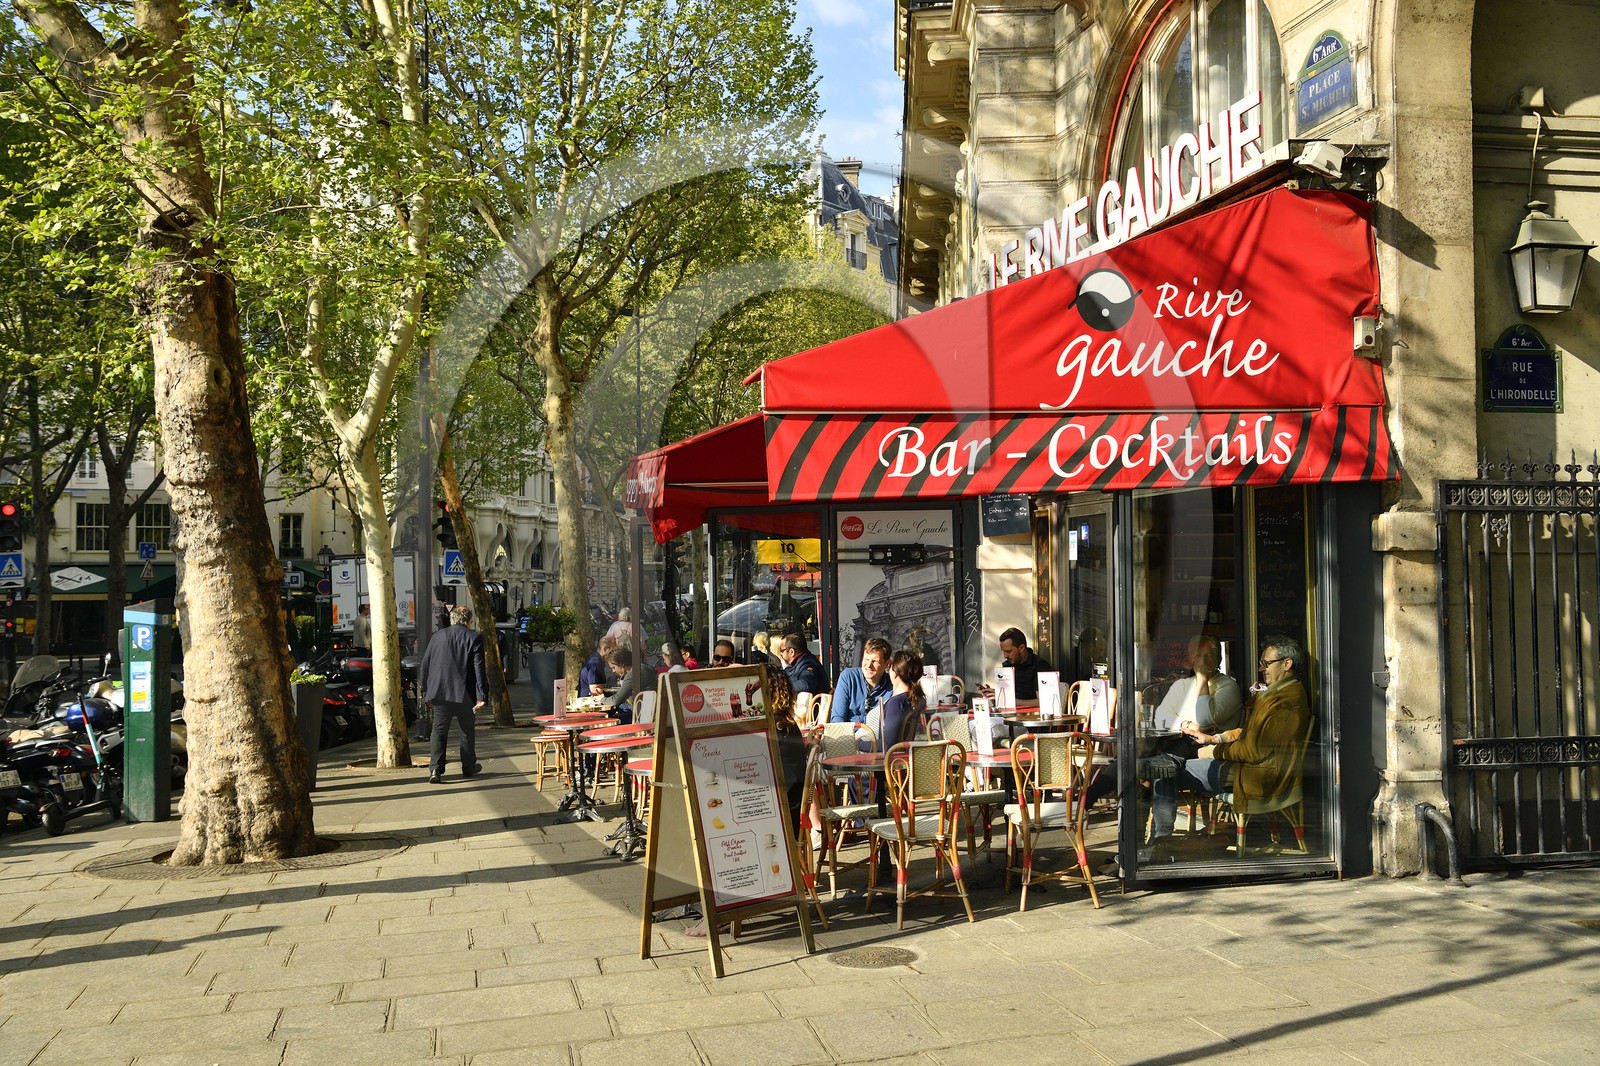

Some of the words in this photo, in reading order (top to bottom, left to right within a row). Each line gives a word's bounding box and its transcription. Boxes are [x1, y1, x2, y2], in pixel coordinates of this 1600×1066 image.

[1309, 70, 1340, 98] PLACE
[1312, 85, 1347, 113] MICHEL
[1025, 196, 1091, 277] RIVE
[1097, 90, 1264, 247] GAUCHE
[1153, 278, 1252, 319] Rive
[1040, 314, 1280, 410] gauche
[1512, 361, 1533, 373] RUE
[1490, 388, 1556, 400] L'HIRONDELLE
[878, 425, 992, 478] Bar
[1048, 414, 1293, 482] Cocktails
[867, 519, 883, 535] Le
[886, 519, 911, 534] Rive
[912, 519, 948, 540] Gauche
[781, 543, 795, 553] 10
[771, 563, 782, 572] LE
[137, 627, 151, 648] P
[683, 693, 703, 704] Coca-Cola
[694, 743, 707, 751] Rive
